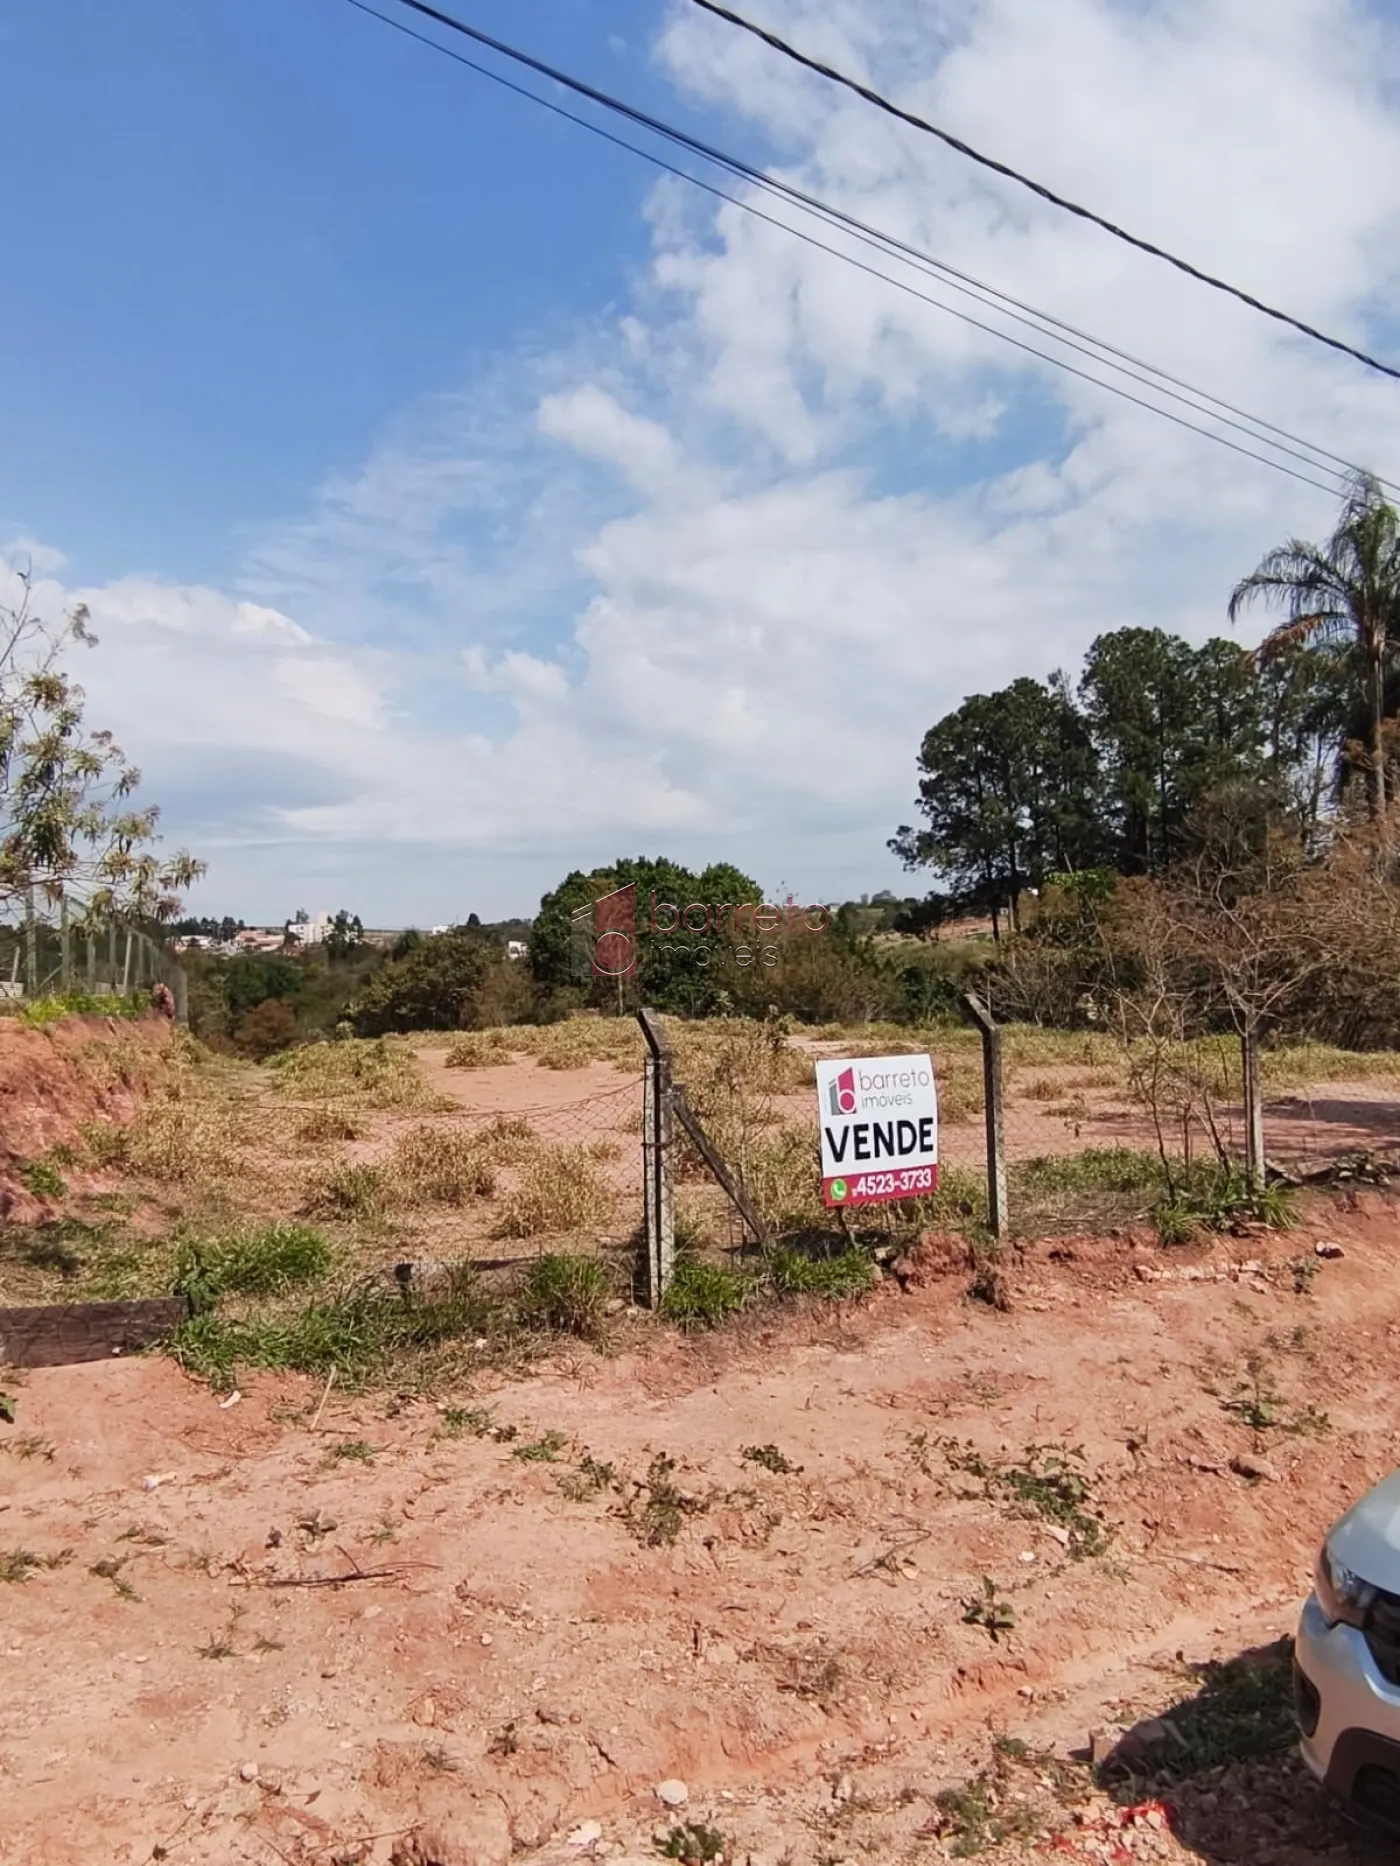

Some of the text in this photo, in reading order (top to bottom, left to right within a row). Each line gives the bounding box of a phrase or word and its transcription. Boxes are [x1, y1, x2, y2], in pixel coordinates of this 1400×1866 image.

[859, 1069, 930, 1091] barreto
[862, 1093, 913, 1108] imóveis
[825, 1117, 934, 1163] VENDE
[857, 1169, 932, 1197] 4523-3733
